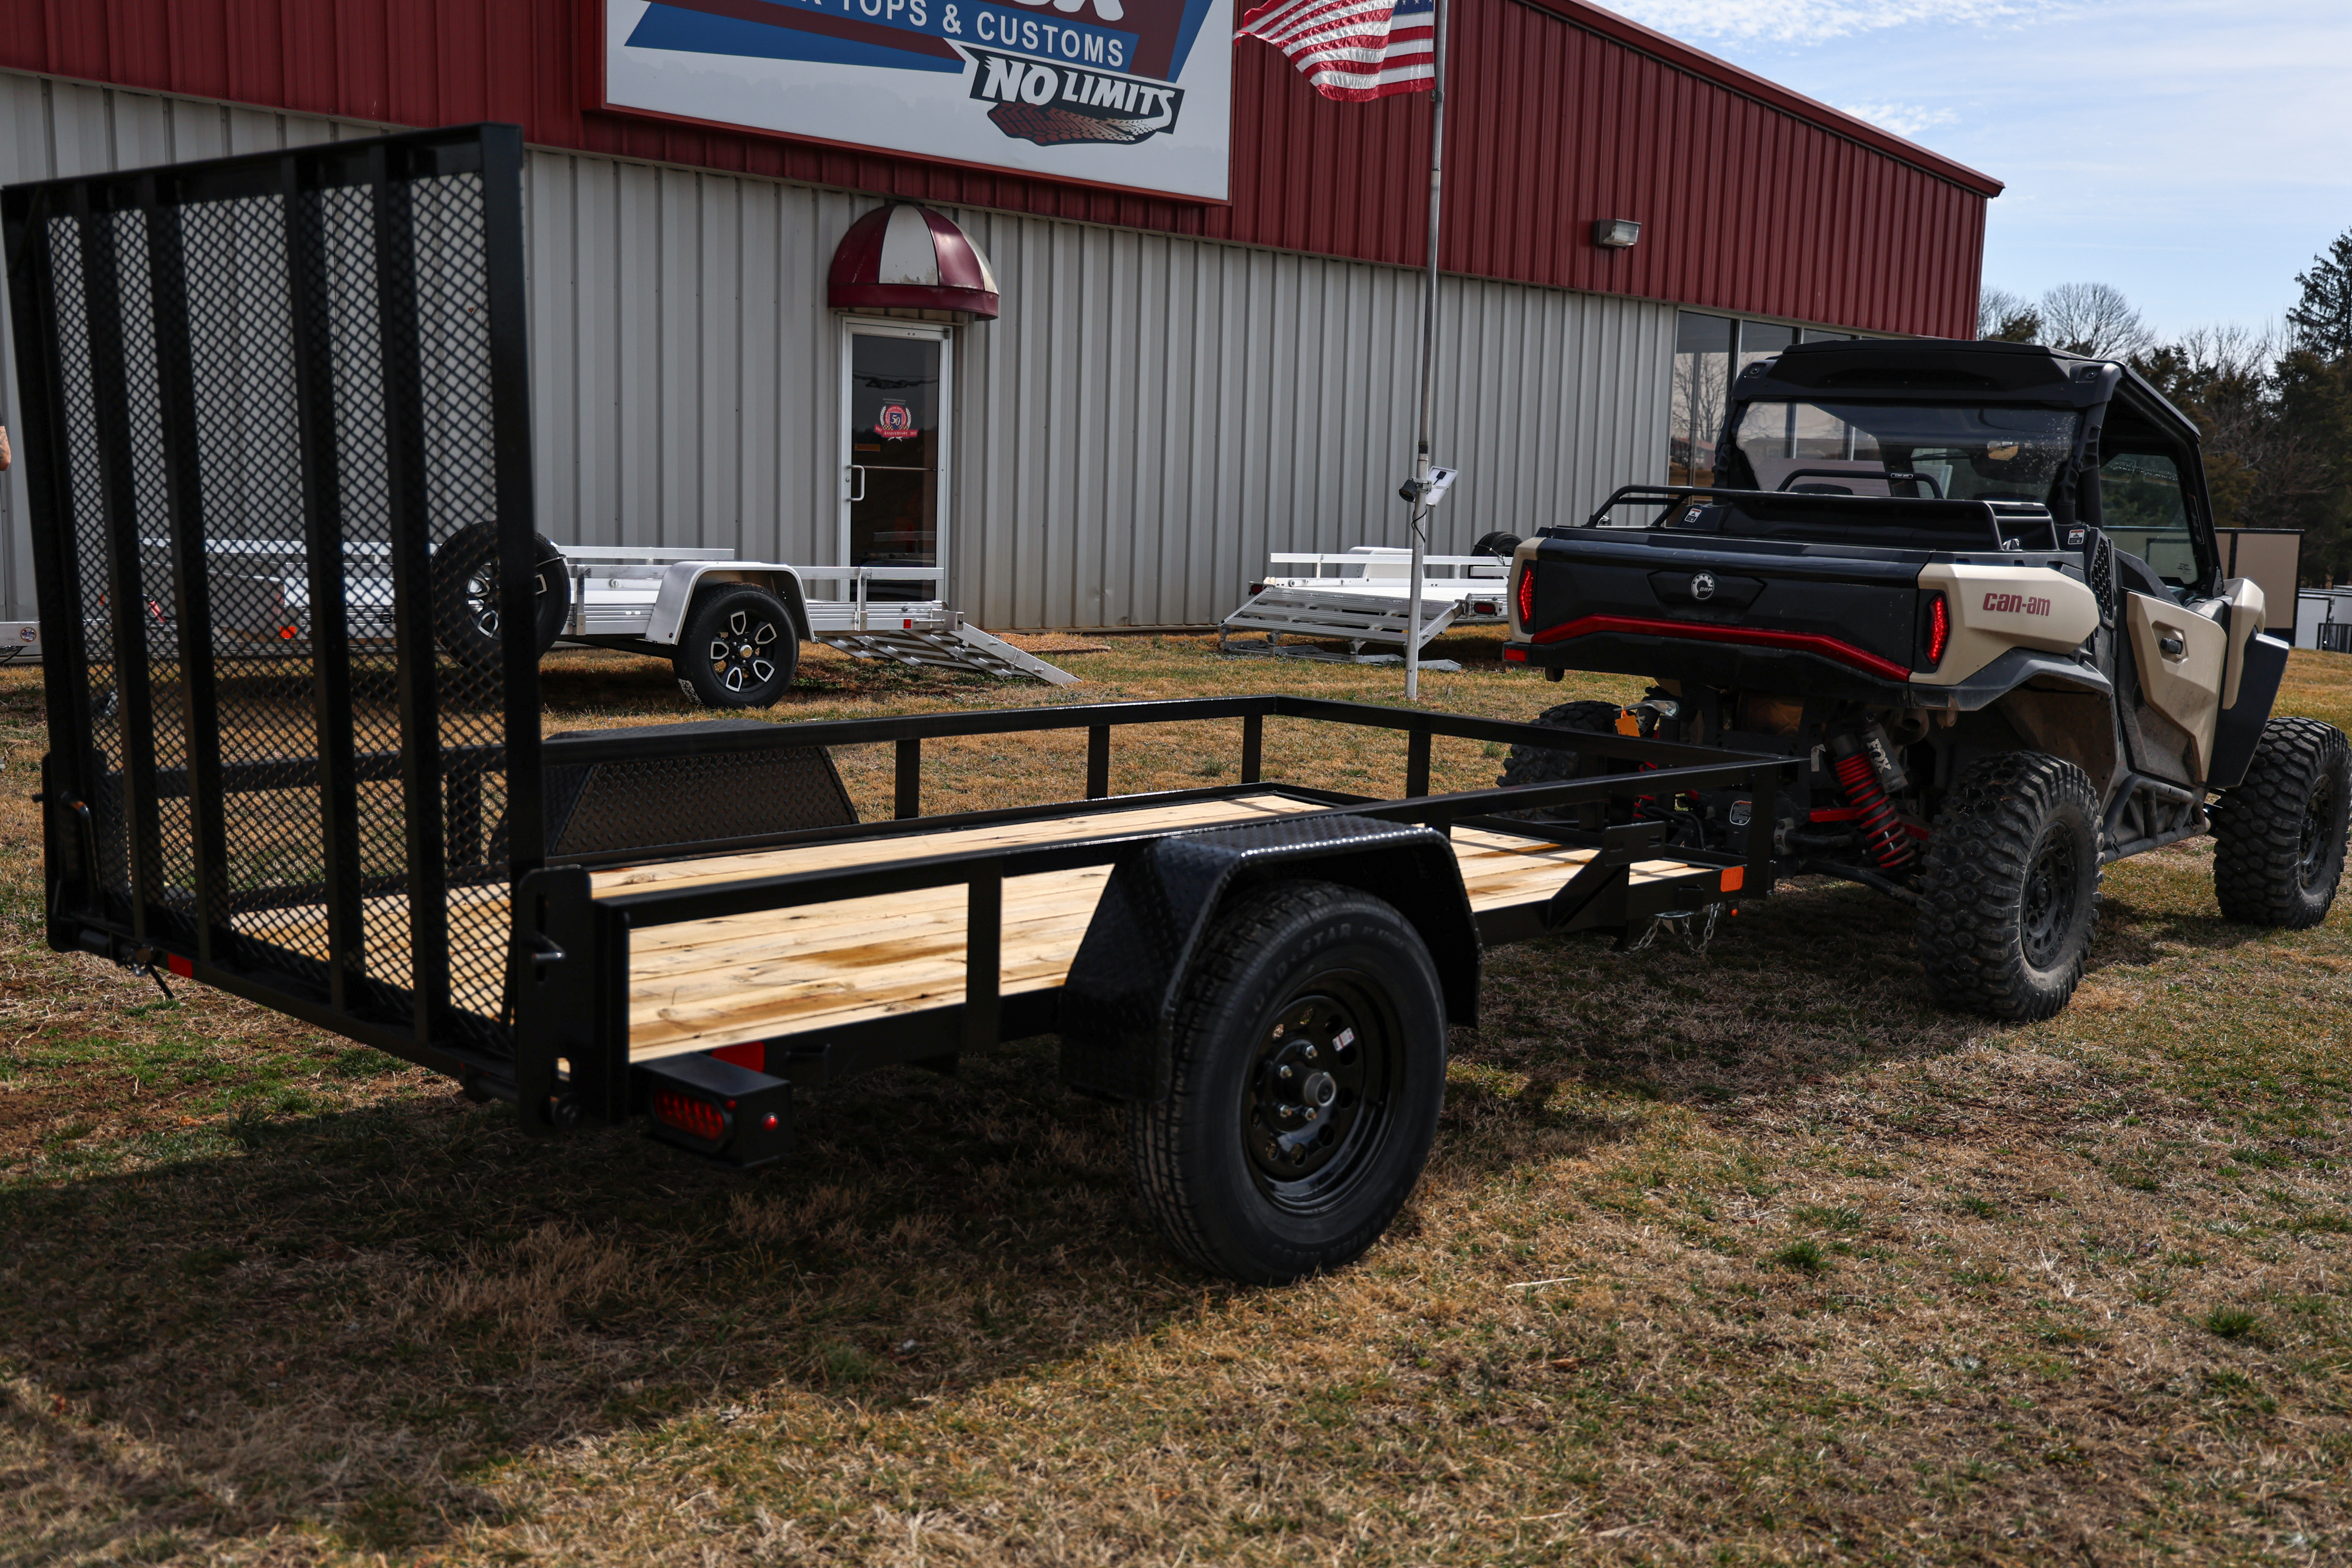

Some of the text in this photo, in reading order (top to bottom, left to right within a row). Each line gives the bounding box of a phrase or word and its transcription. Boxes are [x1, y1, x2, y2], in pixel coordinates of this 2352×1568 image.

[943, 4, 962, 35] &
[977, 11, 1124, 67] CUSTOMS
[981, 55, 1175, 128] NO LIMITS
[890, 414, 901, 426] 50
[1983, 593, 2050, 617] can-am
[1866, 738, 1892, 774] FOX
